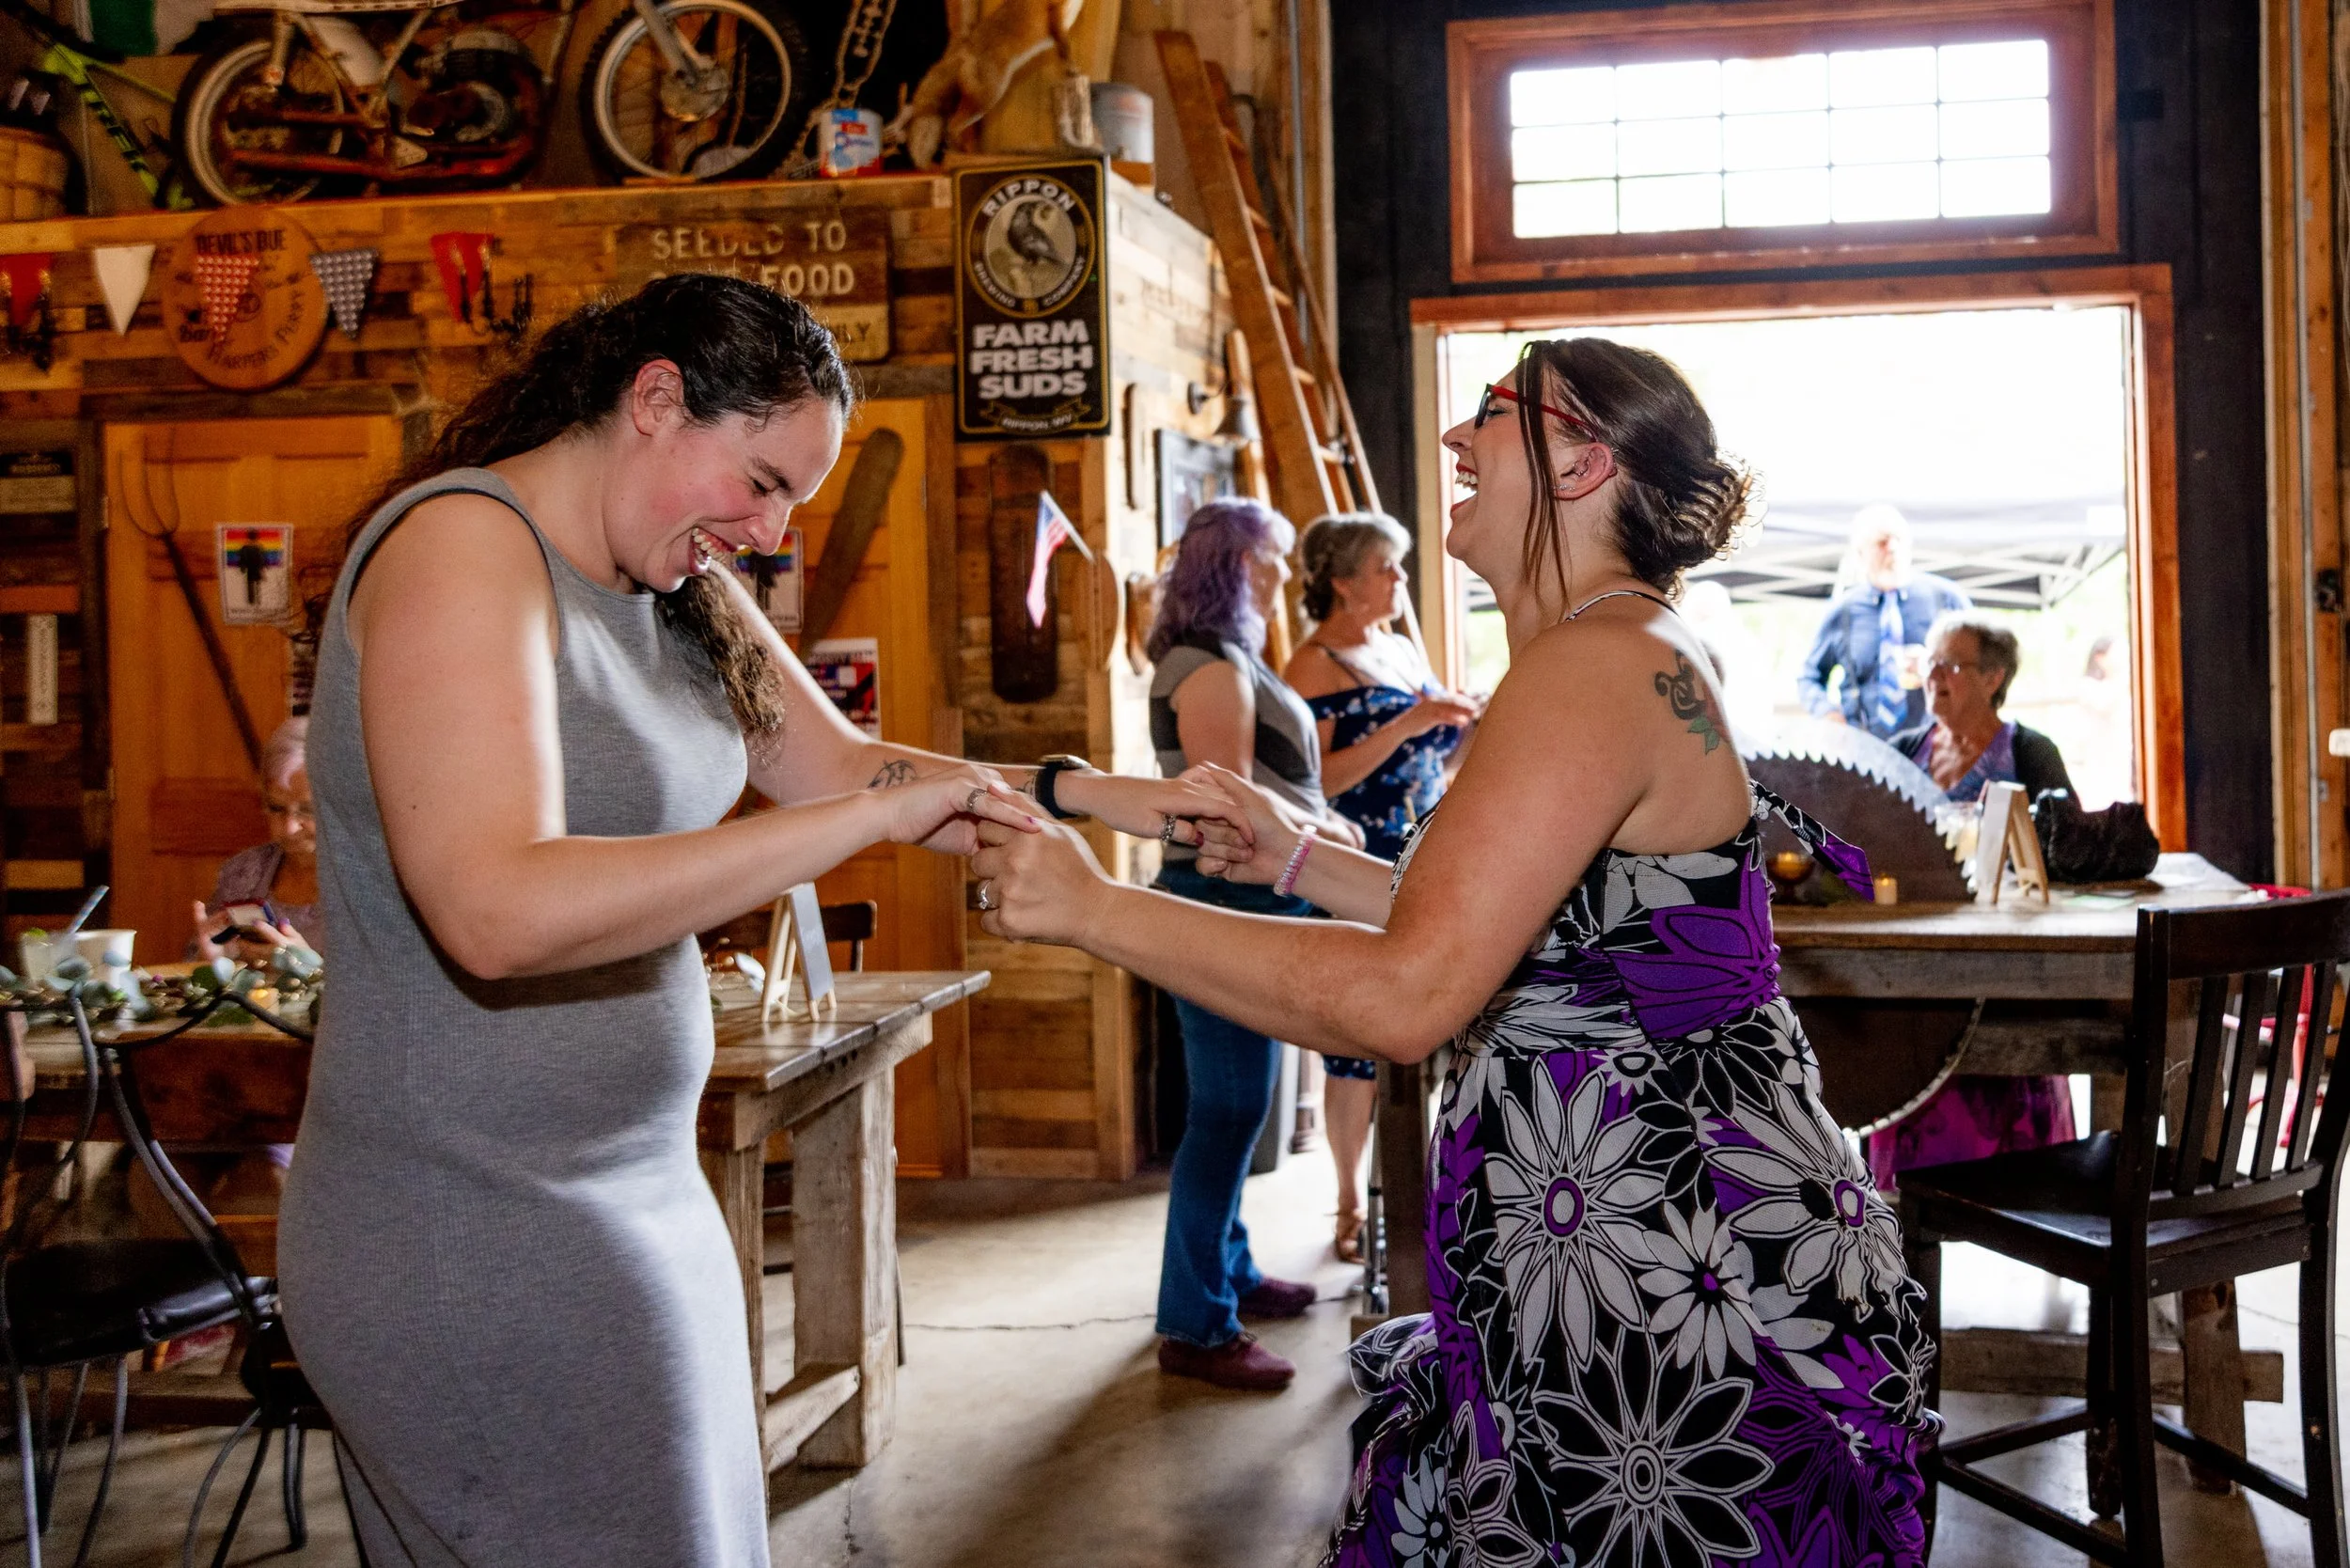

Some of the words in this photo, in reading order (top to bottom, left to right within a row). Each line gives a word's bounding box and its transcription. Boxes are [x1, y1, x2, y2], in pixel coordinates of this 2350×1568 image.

[982, 179, 1075, 217] RIPPON
[804, 219, 846, 253] TO
[760, 262, 855, 297] FOOD
[830, 321, 871, 344] NLY
[972, 320, 1089, 348] FARM
[969, 345, 1093, 374] FRESH
[978, 370, 1087, 400] SUDS
